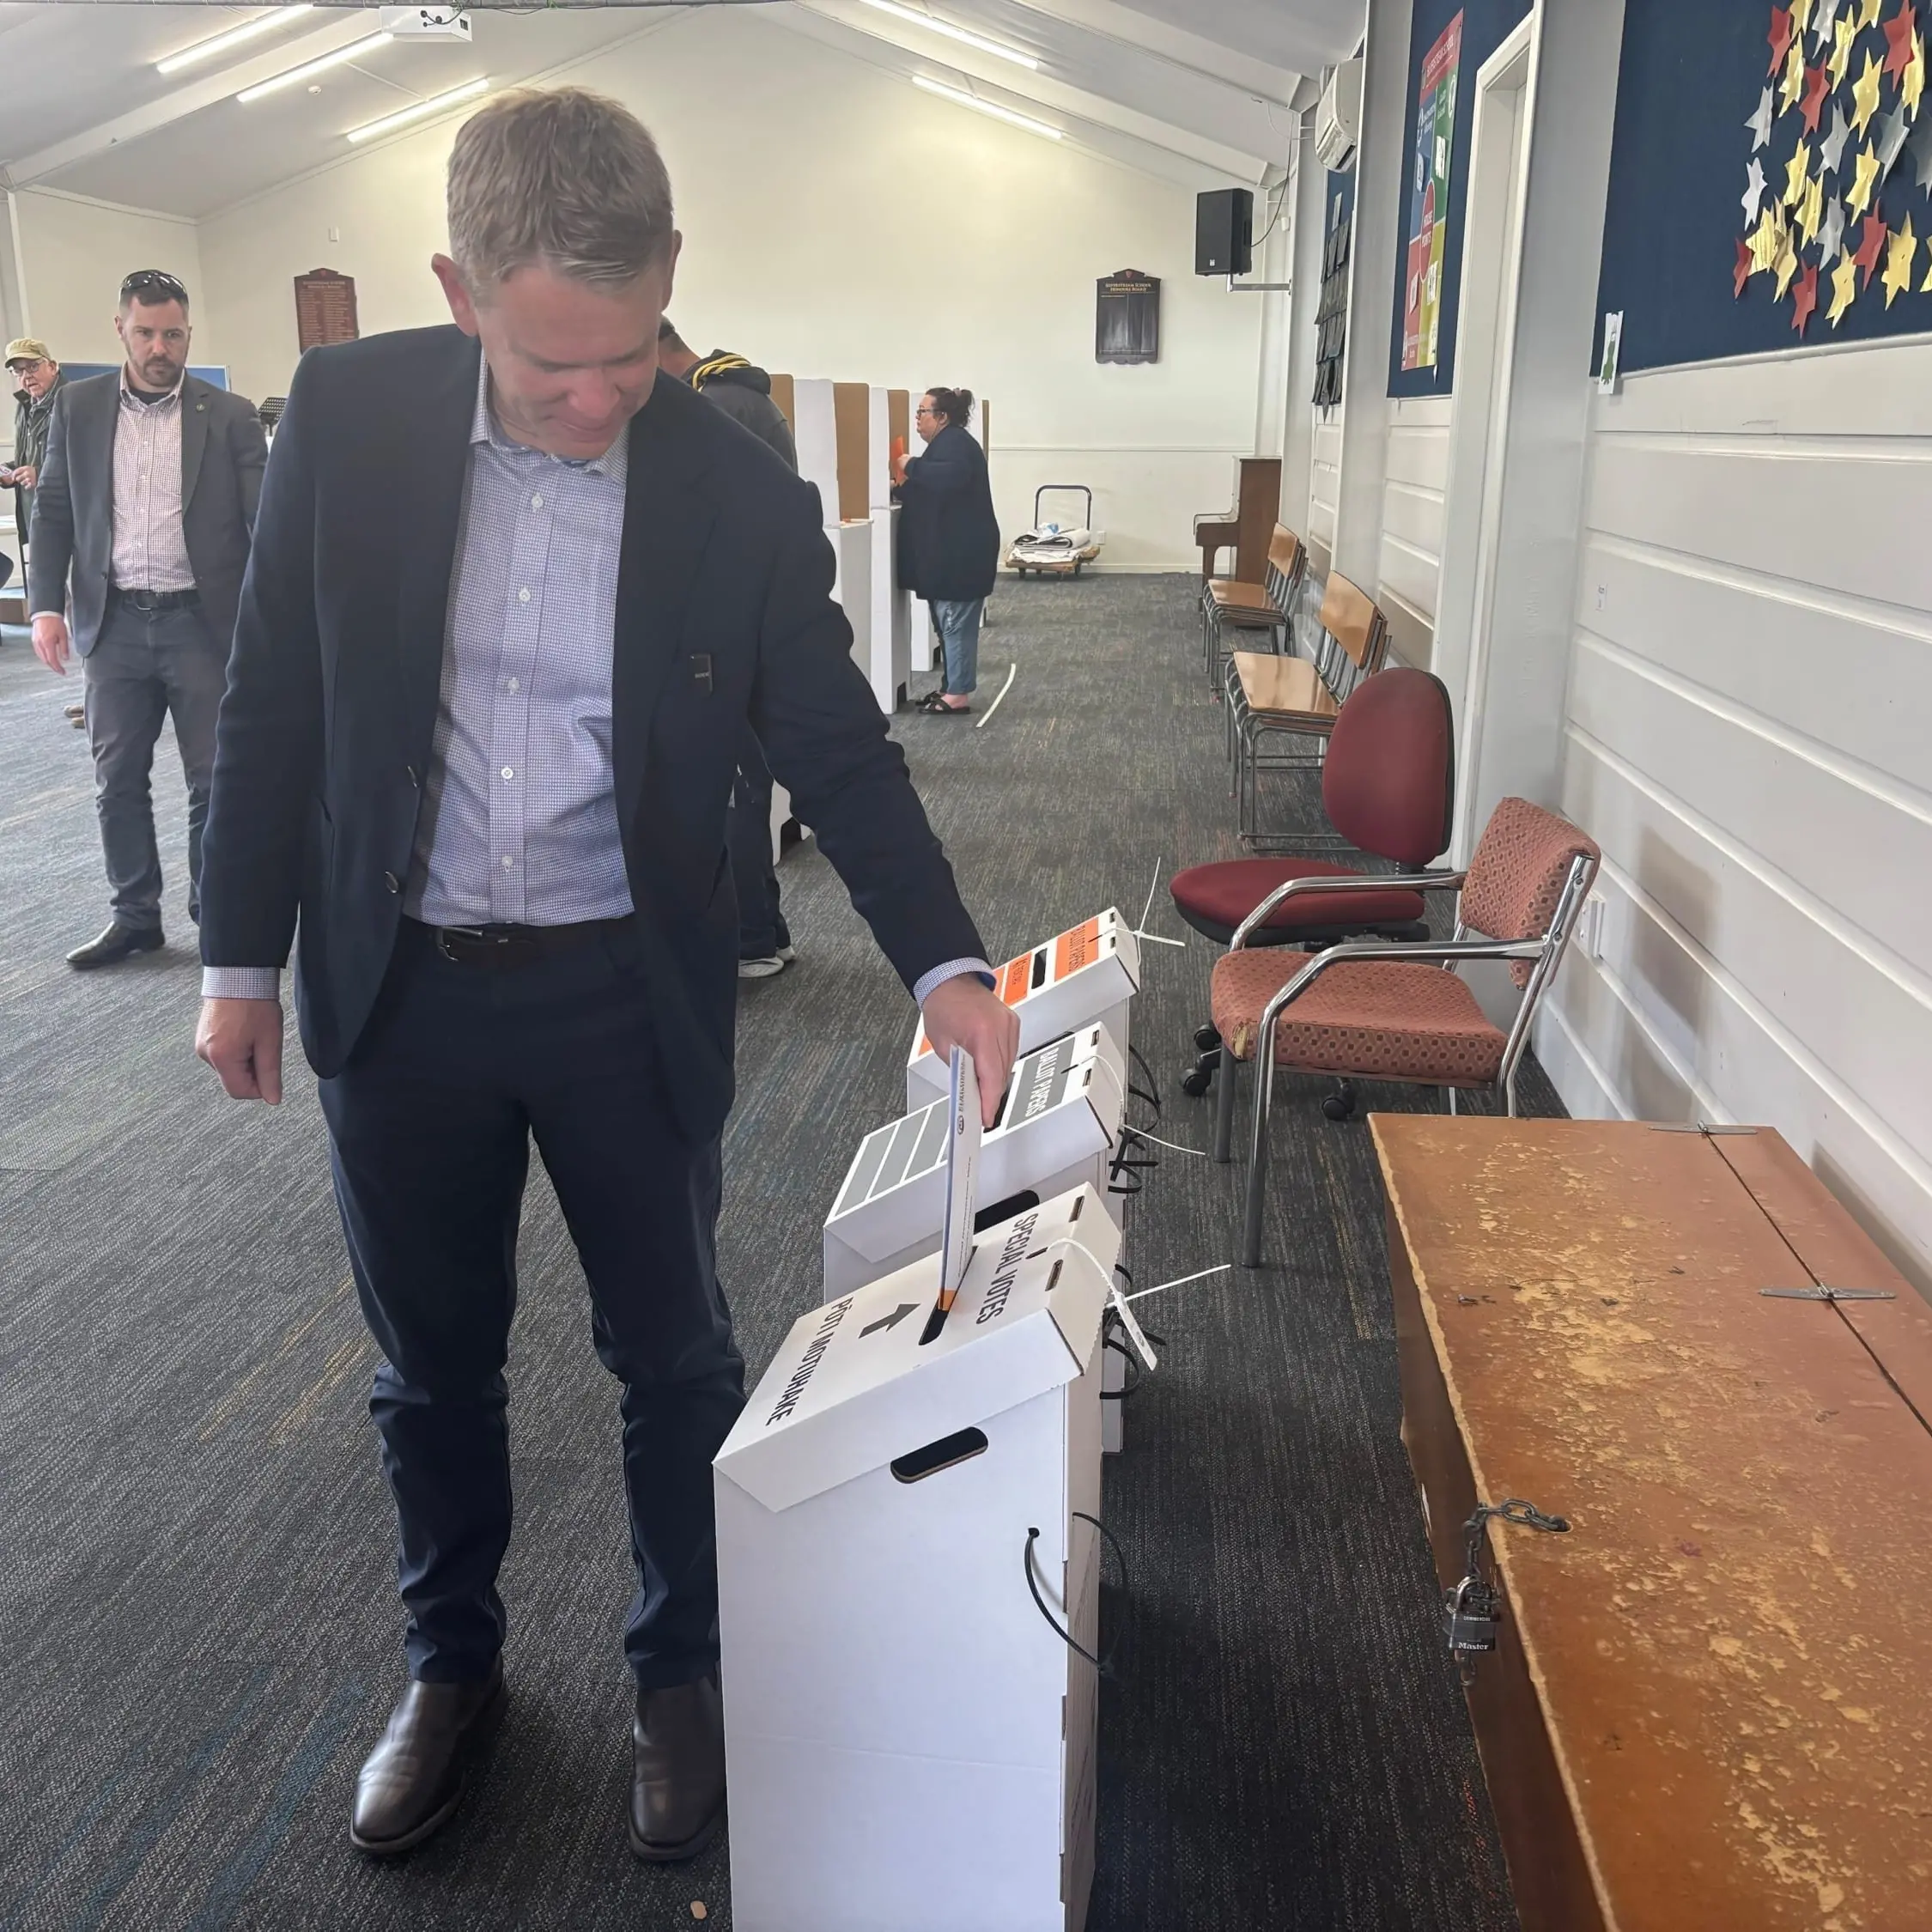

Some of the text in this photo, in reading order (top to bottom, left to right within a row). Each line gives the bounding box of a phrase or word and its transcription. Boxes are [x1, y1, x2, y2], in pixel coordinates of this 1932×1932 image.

[1024, 1047, 1060, 1117] BALLOT PAPERS
[975, 1212, 1039, 1324] SPECIAL VOTES
[765, 1331, 835, 1426] MOTUHAKE
[1458, 1641, 1489, 1650] Master
